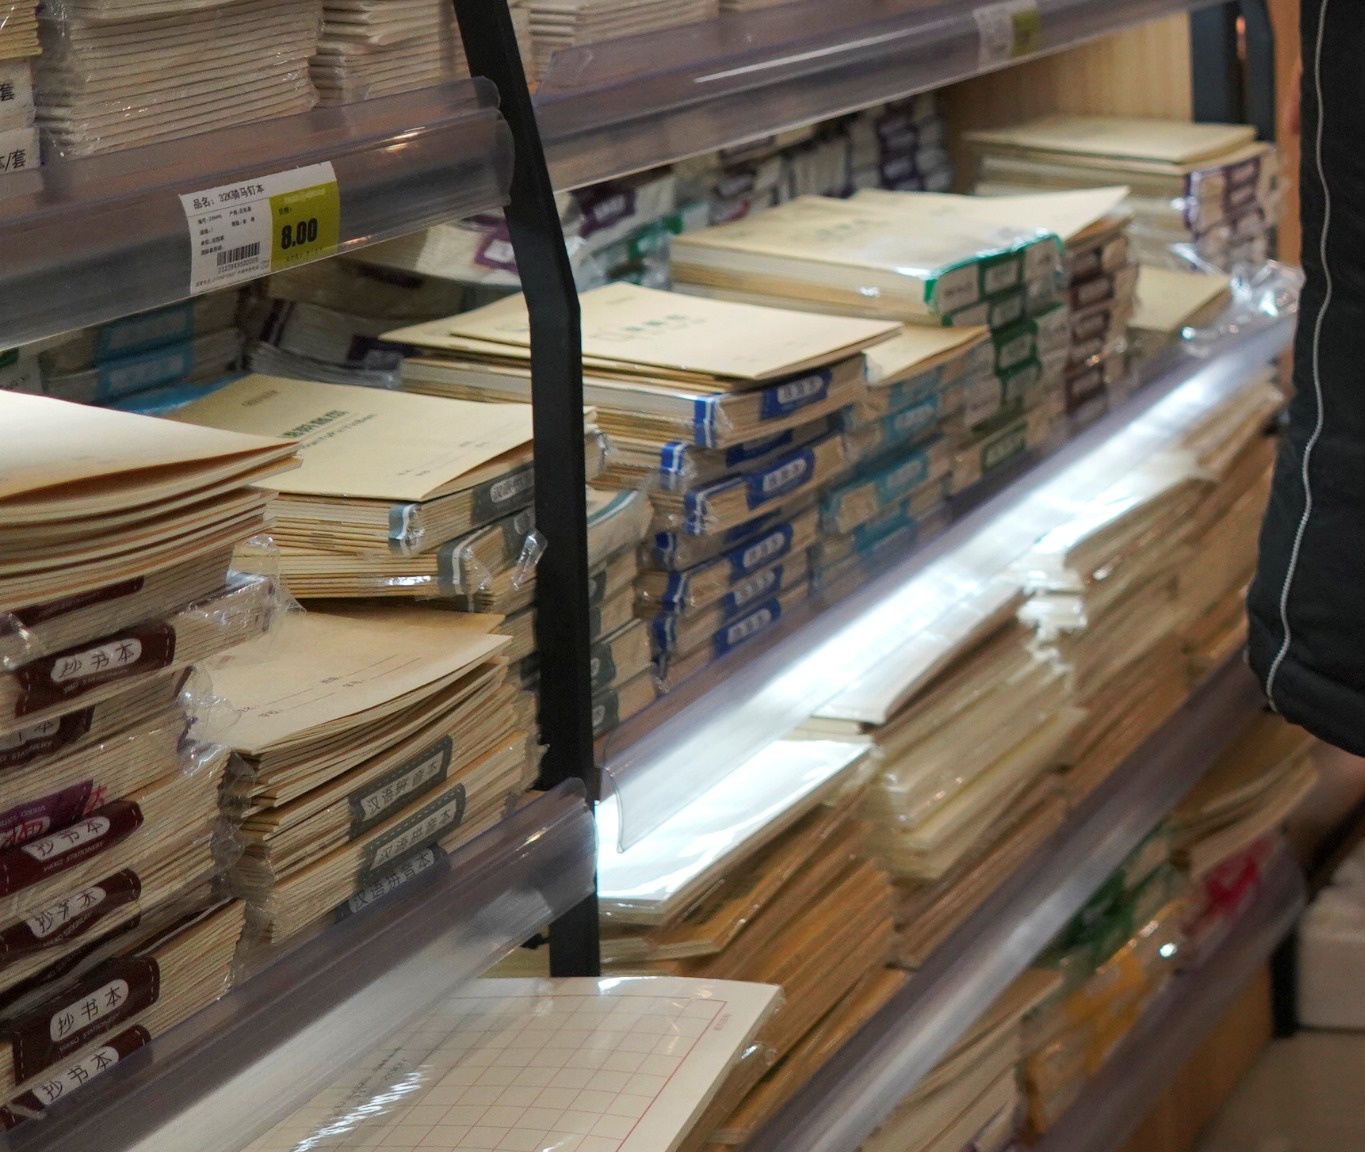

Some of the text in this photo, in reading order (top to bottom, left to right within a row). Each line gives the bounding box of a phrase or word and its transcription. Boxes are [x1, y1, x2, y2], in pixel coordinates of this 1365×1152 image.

[281, 217, 318, 250] 8.00
[56, 985, 122, 1038] 抄书本
[41, 1050, 113, 1101] 抄书本
